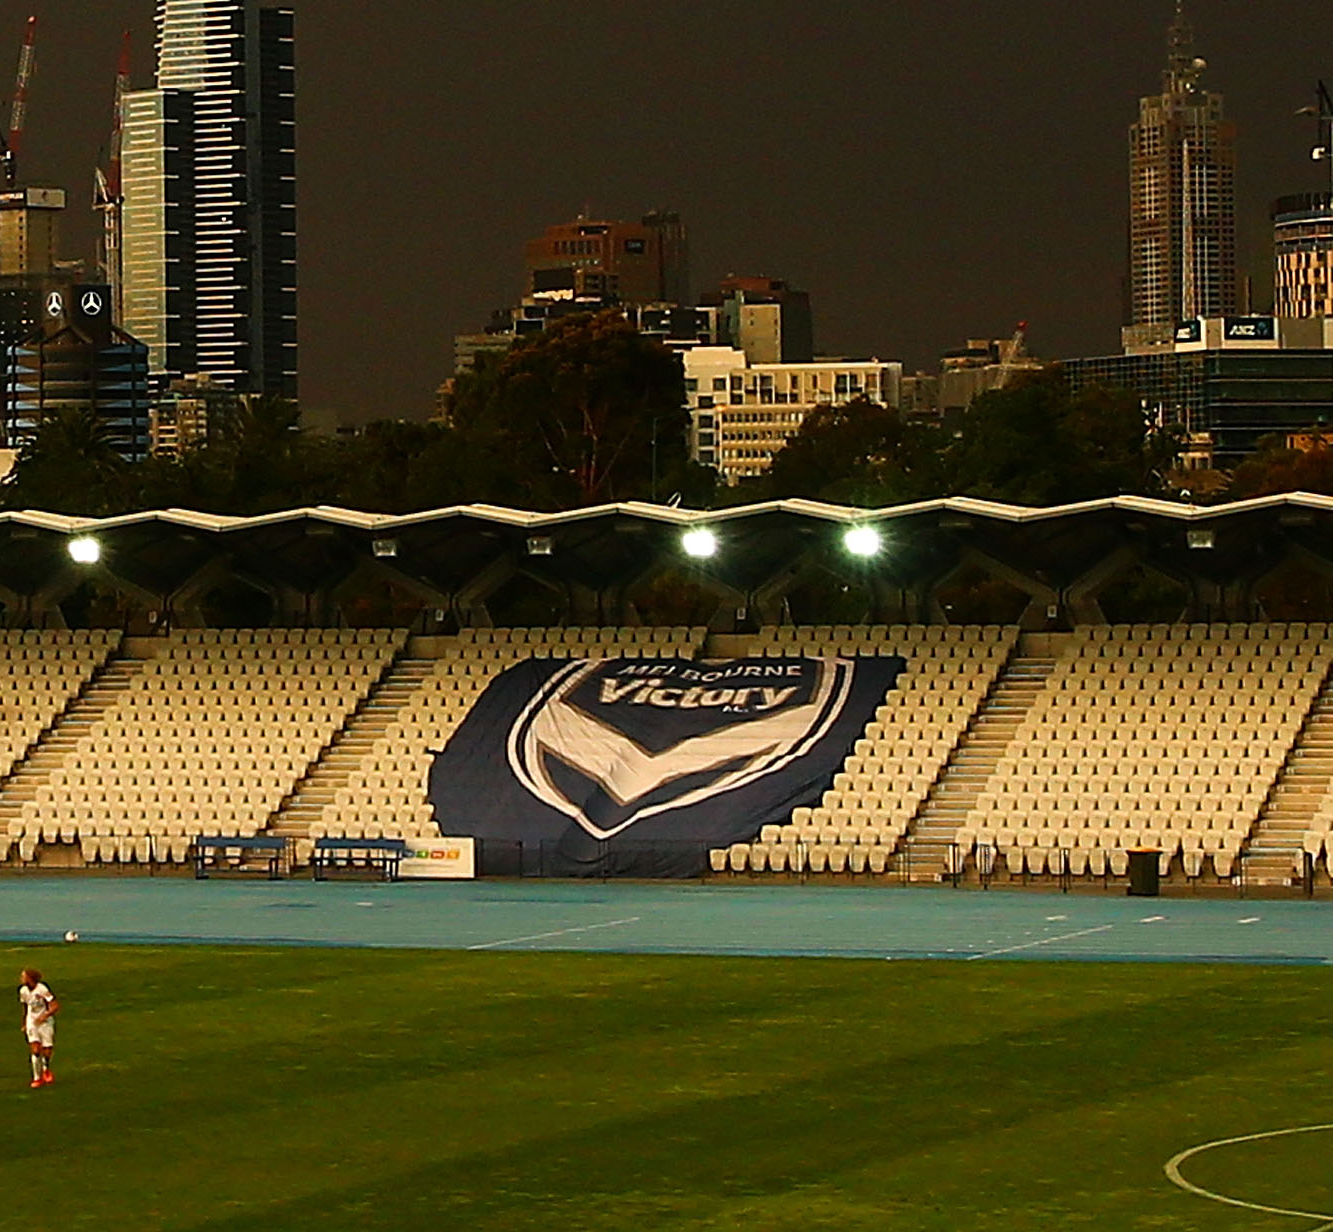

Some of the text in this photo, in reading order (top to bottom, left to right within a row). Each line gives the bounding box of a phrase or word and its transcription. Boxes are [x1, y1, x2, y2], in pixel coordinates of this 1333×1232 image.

[1229, 324, 1256, 336] ANZ
[617, 664, 802, 682] MELBOURNE
[600, 677, 800, 709] Victory
